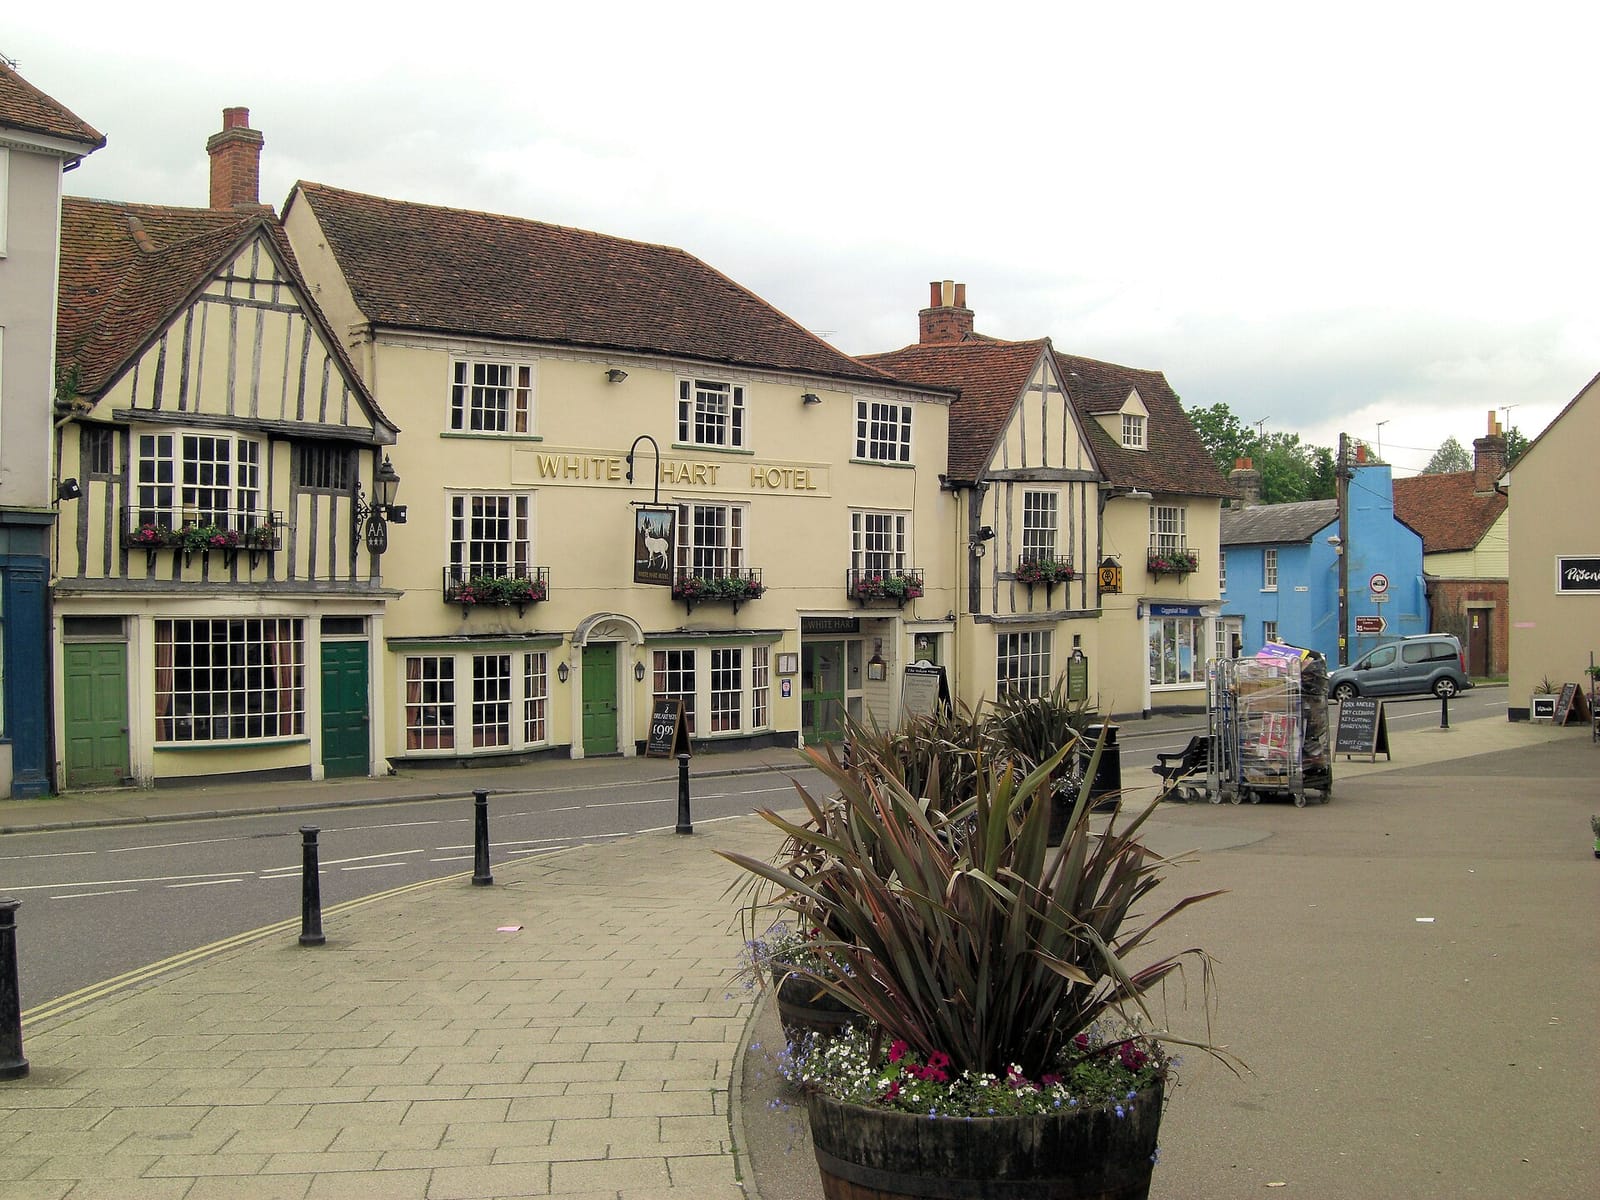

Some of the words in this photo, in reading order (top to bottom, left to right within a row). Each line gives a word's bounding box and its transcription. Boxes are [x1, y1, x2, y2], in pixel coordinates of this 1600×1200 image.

[537, 455, 621, 481] WHITE
[660, 462, 720, 486] HART
[751, 466, 817, 490] HOTEL
[368, 523, 384, 536] AA
[807, 620, 833, 629] WHITE
[834, 620, 853, 629] HART
